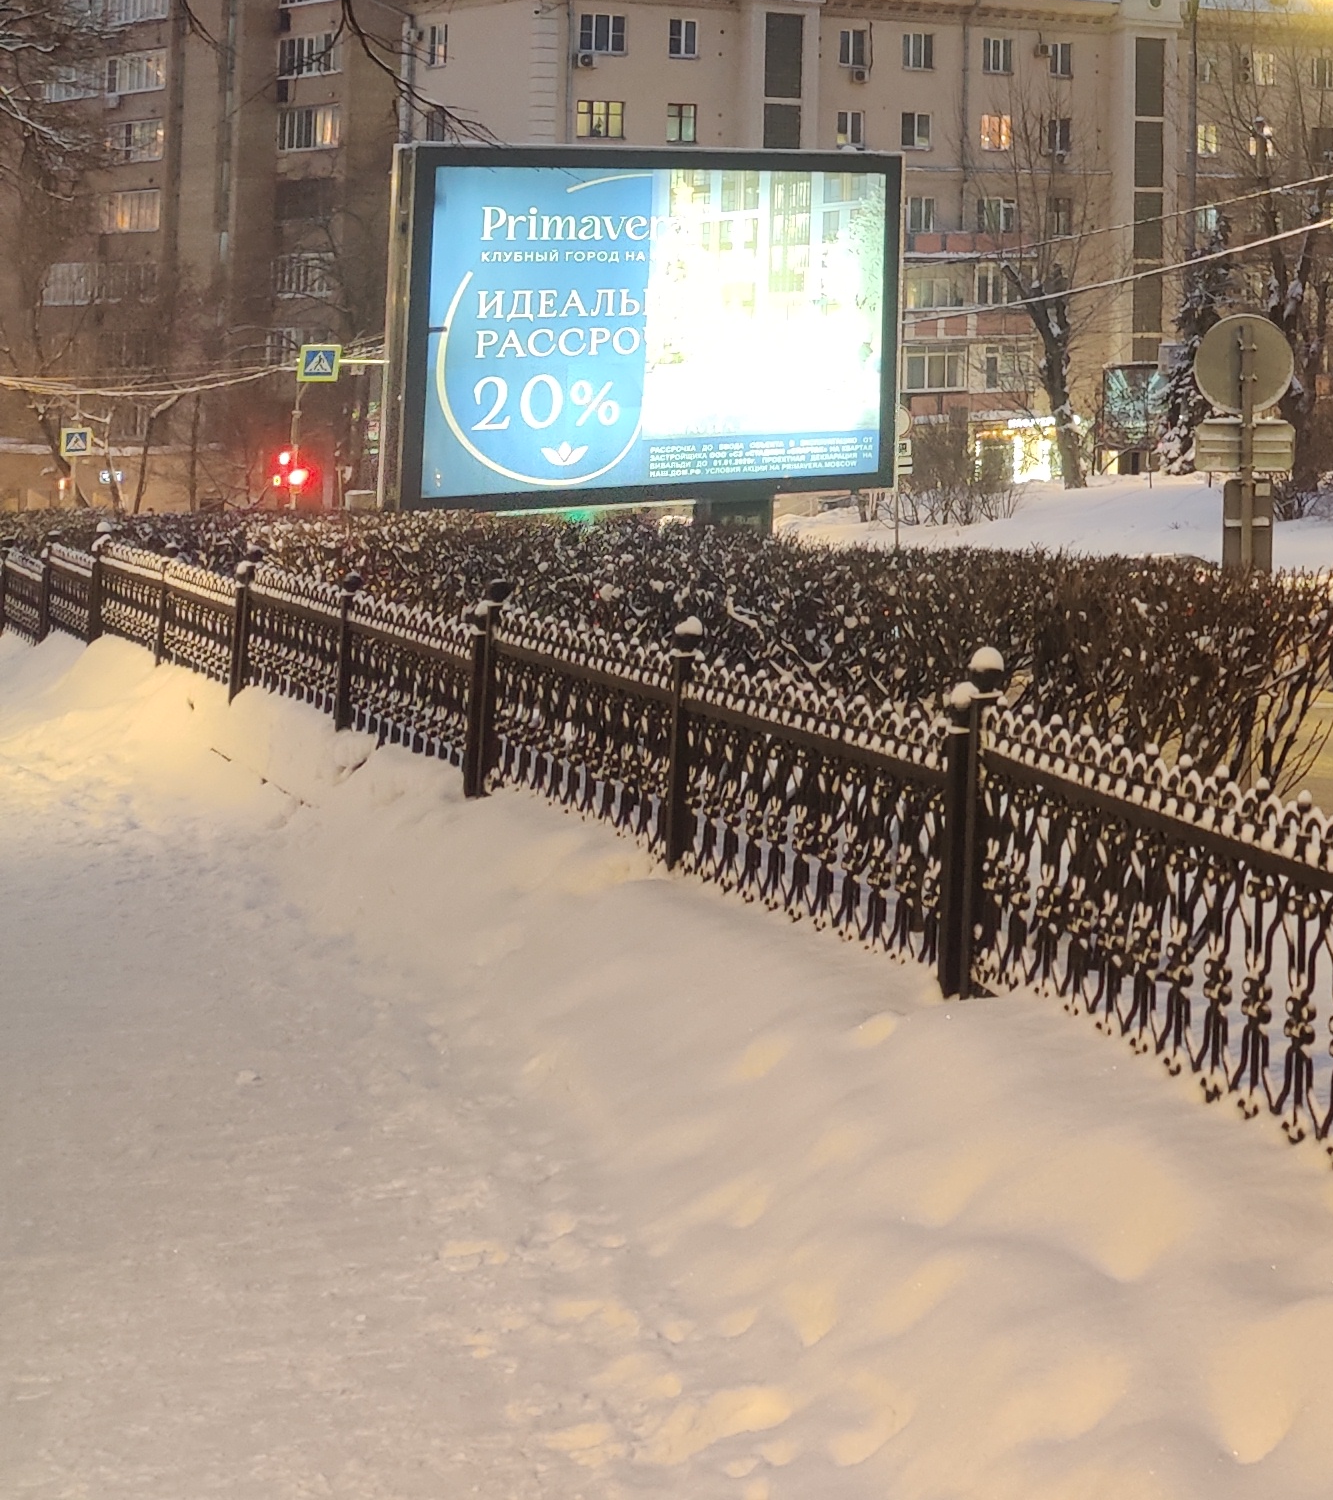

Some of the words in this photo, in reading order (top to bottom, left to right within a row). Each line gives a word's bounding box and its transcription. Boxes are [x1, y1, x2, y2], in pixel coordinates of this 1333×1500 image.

[481, 250, 559, 262] КЛУБНЫЙ
[565, 251, 620, 263] ГОРОД
[625, 251, 646, 262] НА
[471, 373, 620, 431] 20%
[702, 444, 713, 452] ДО
[696, 460, 708, 468] ДО
